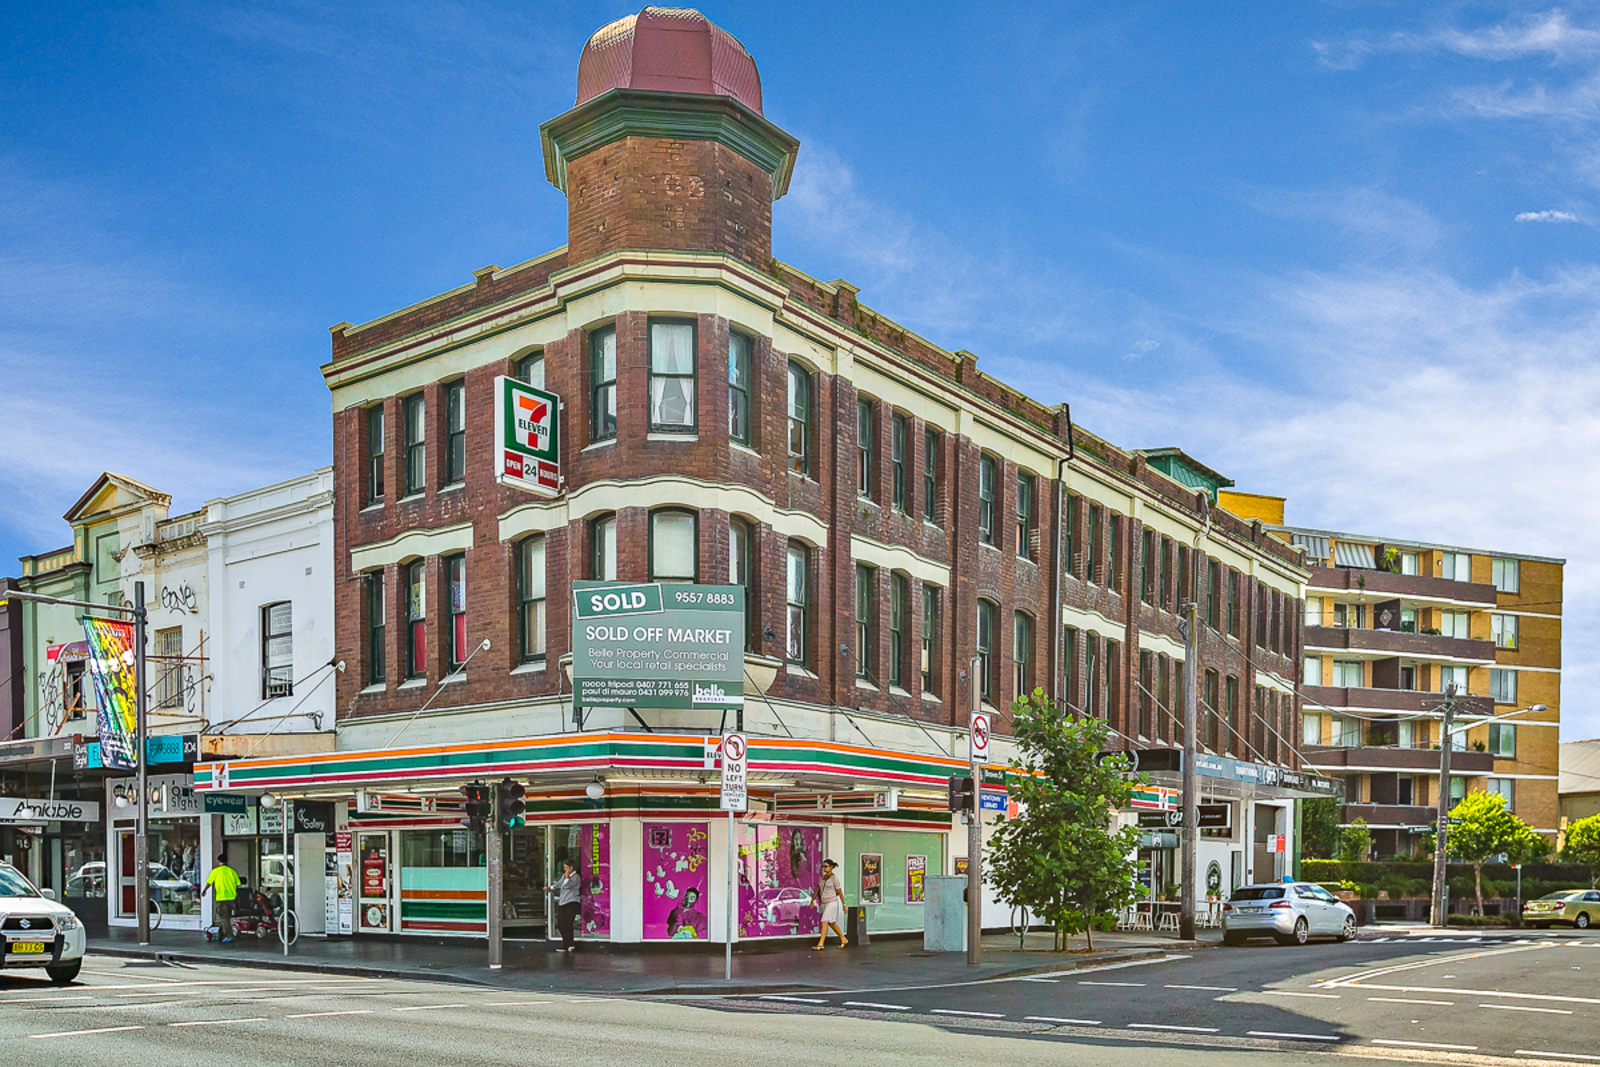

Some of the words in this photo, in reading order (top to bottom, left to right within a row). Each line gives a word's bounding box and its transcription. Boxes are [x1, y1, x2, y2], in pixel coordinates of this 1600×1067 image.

[519, 395, 547, 448] 7
[506, 458, 521, 471] OPEN
[524, 464, 537, 477] 24
[540, 468, 558, 481] HOURS
[590, 592, 646, 612] SOLD
[675, 592, 702, 604] 9557
[706, 592, 734, 604] 8883
[586, 626, 628, 641] SOLD
[633, 627, 664, 642] OFF
[668, 628, 732, 644] MARKET
[588, 648, 614, 658] Belle
[616, 648, 660, 660] Property
[664, 649, 729, 661] Commercial
[590, 659, 614, 669] Your
[616, 659, 644, 670] local
[646, 660, 672, 670] retail
[674, 661, 726, 672] specialists
[696, 684, 724, 696] belle
[184, 742, 196, 753] 204
[728, 764, 740, 773] NO
[206, 797, 244, 806] eyewear
[13, 802, 82, 818] Amiable
